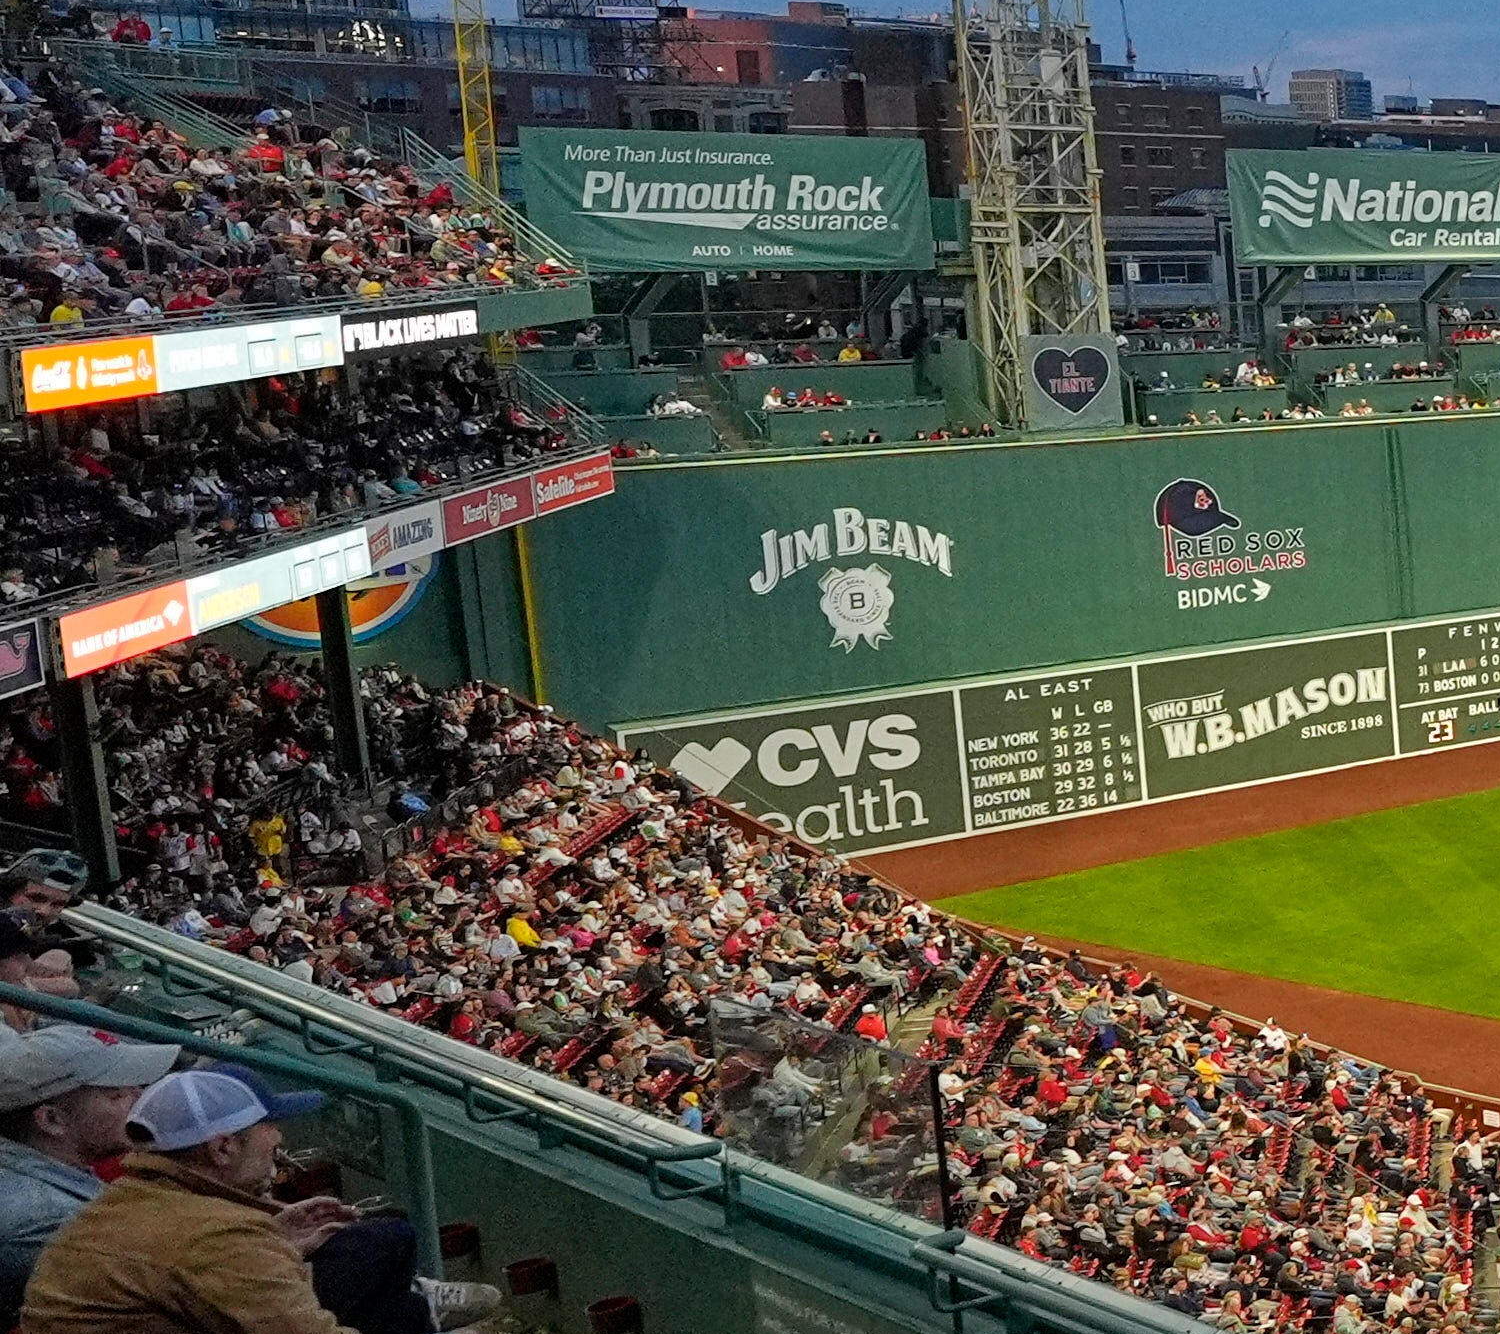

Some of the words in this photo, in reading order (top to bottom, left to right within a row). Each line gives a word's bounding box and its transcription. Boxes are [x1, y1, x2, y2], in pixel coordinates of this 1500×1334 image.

[564, 144, 611, 163] More
[615, 145, 657, 164] Than
[660, 146, 692, 165] Just
[694, 147, 775, 166] Insurance.
[582, 170, 776, 214] Plymouth
[786, 173, 885, 212] Rock
[756, 213, 889, 231] assurance
[1390, 229, 1427, 247] Car
[1433, 227, 1500, 247] Rental
[692, 245, 731, 257] AUTO
[753, 245, 794, 257] HOME
[364, 317, 402, 349] BLACK
[403, 314, 436, 343] LIVES
[435, 309, 478, 340] MATTER
[1062, 361, 1080, 377] EL
[1049, 376, 1096, 394] TIANTE
[535, 475, 575, 505] Safelite
[462, 500, 489, 527] Ninety
[393, 517, 434, 550] AMAZING
[1175, 535, 1236, 560] RED
[1245, 528, 1305, 553] SOX
[749, 523, 832, 595] JIM
[833, 506, 953, 577] BEAM
[1176, 551, 1306, 579] SCHOLARS
[848, 592, 866, 610] B
[1177, 583, 1248, 610] BIDMC
[1442, 659, 1467, 674] LAA
[1004, 687, 1031, 702] AL
[1039, 678, 1093, 697] EAST
[1433, 674, 1478, 694] BOSTON
[1093, 699, 1114, 714] GB
[1146, 701, 1188, 723] WHO
[1191, 693, 1224, 715] BUT
[1421, 711, 1436, 724] AT
[1438, 707, 1459, 720] BAT
[1468, 700, 1499, 716] BALL
[1301, 719, 1348, 740] SINCE
[1350, 713, 1384, 731] 1898
[1428, 720, 1455, 744] 23
[757, 713, 922, 788] CVS
[968, 735, 998, 754] NEW
[1001, 730, 1040, 749] YORK
[969, 749, 1038, 772] TORONTO
[971, 772, 1016, 791] TAMPA
[1019, 766, 1046, 783] BAY
[972, 786, 1032, 809] BOSTON
[730, 778, 930, 845] ealth
[974, 801, 1051, 828] BALTIMORE
